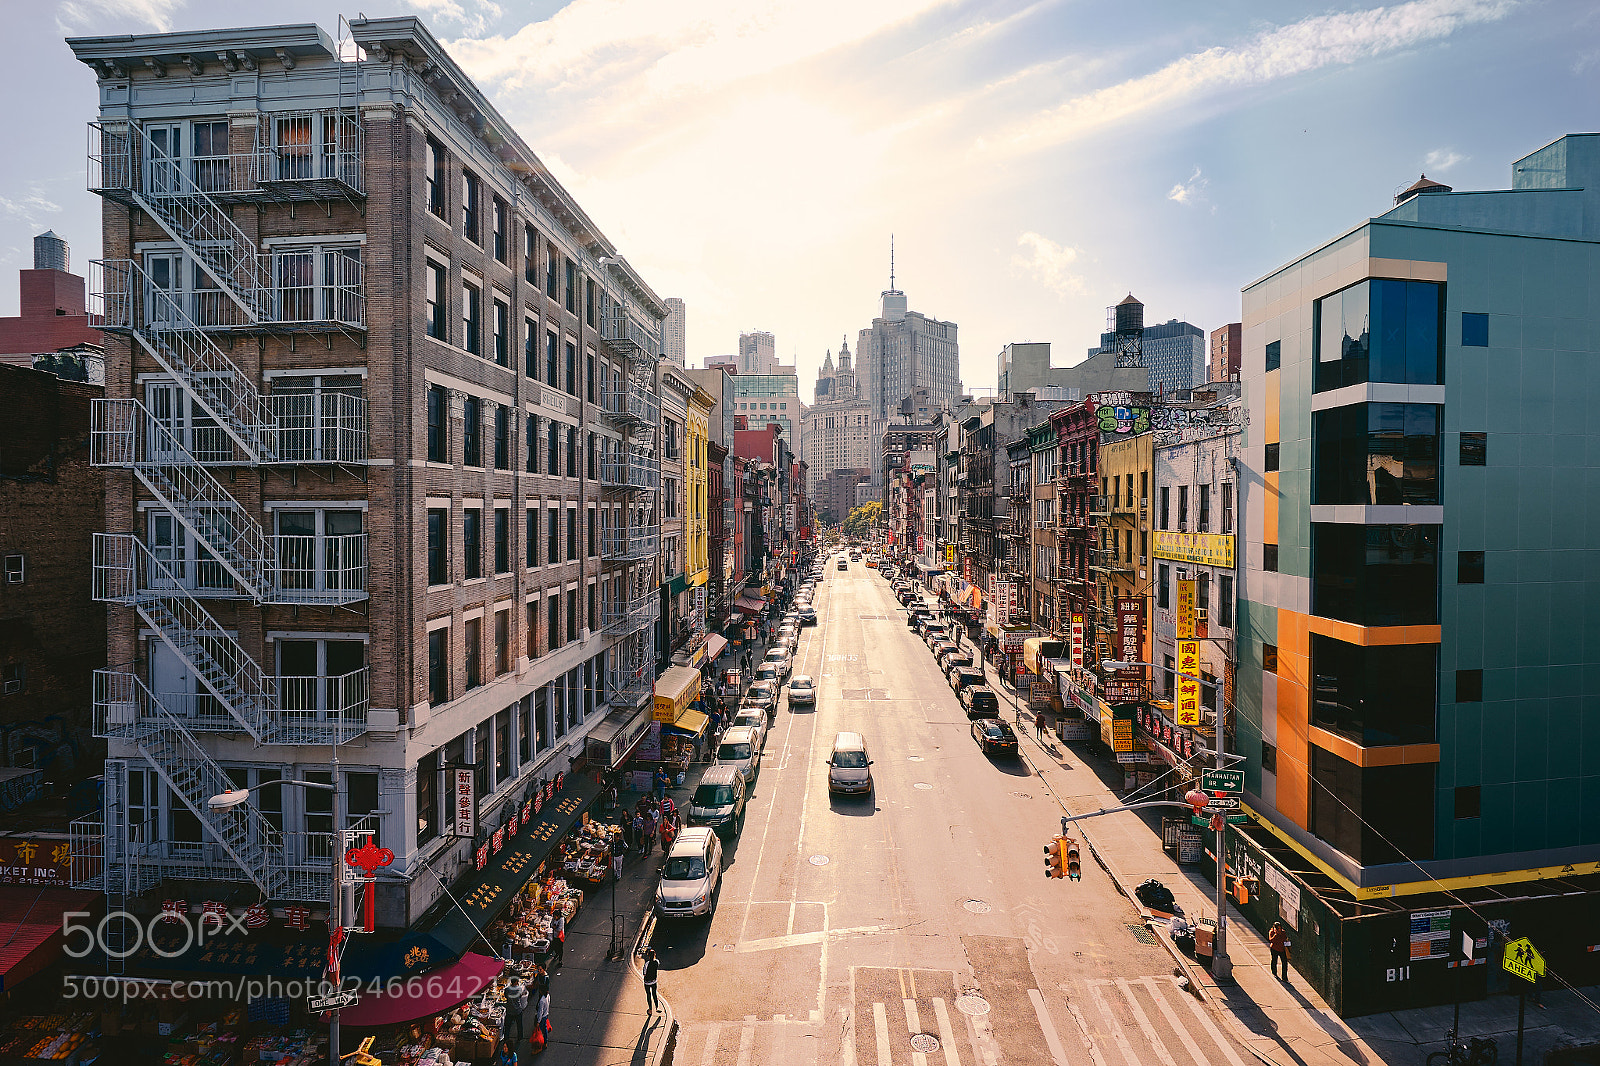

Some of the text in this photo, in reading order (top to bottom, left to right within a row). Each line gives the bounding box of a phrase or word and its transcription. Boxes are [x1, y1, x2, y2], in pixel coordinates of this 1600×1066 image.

[1072, 615, 1083, 623] 66
[1206, 772, 1240, 781] MANHATTAN
[34, 867, 60, 878] INC.
